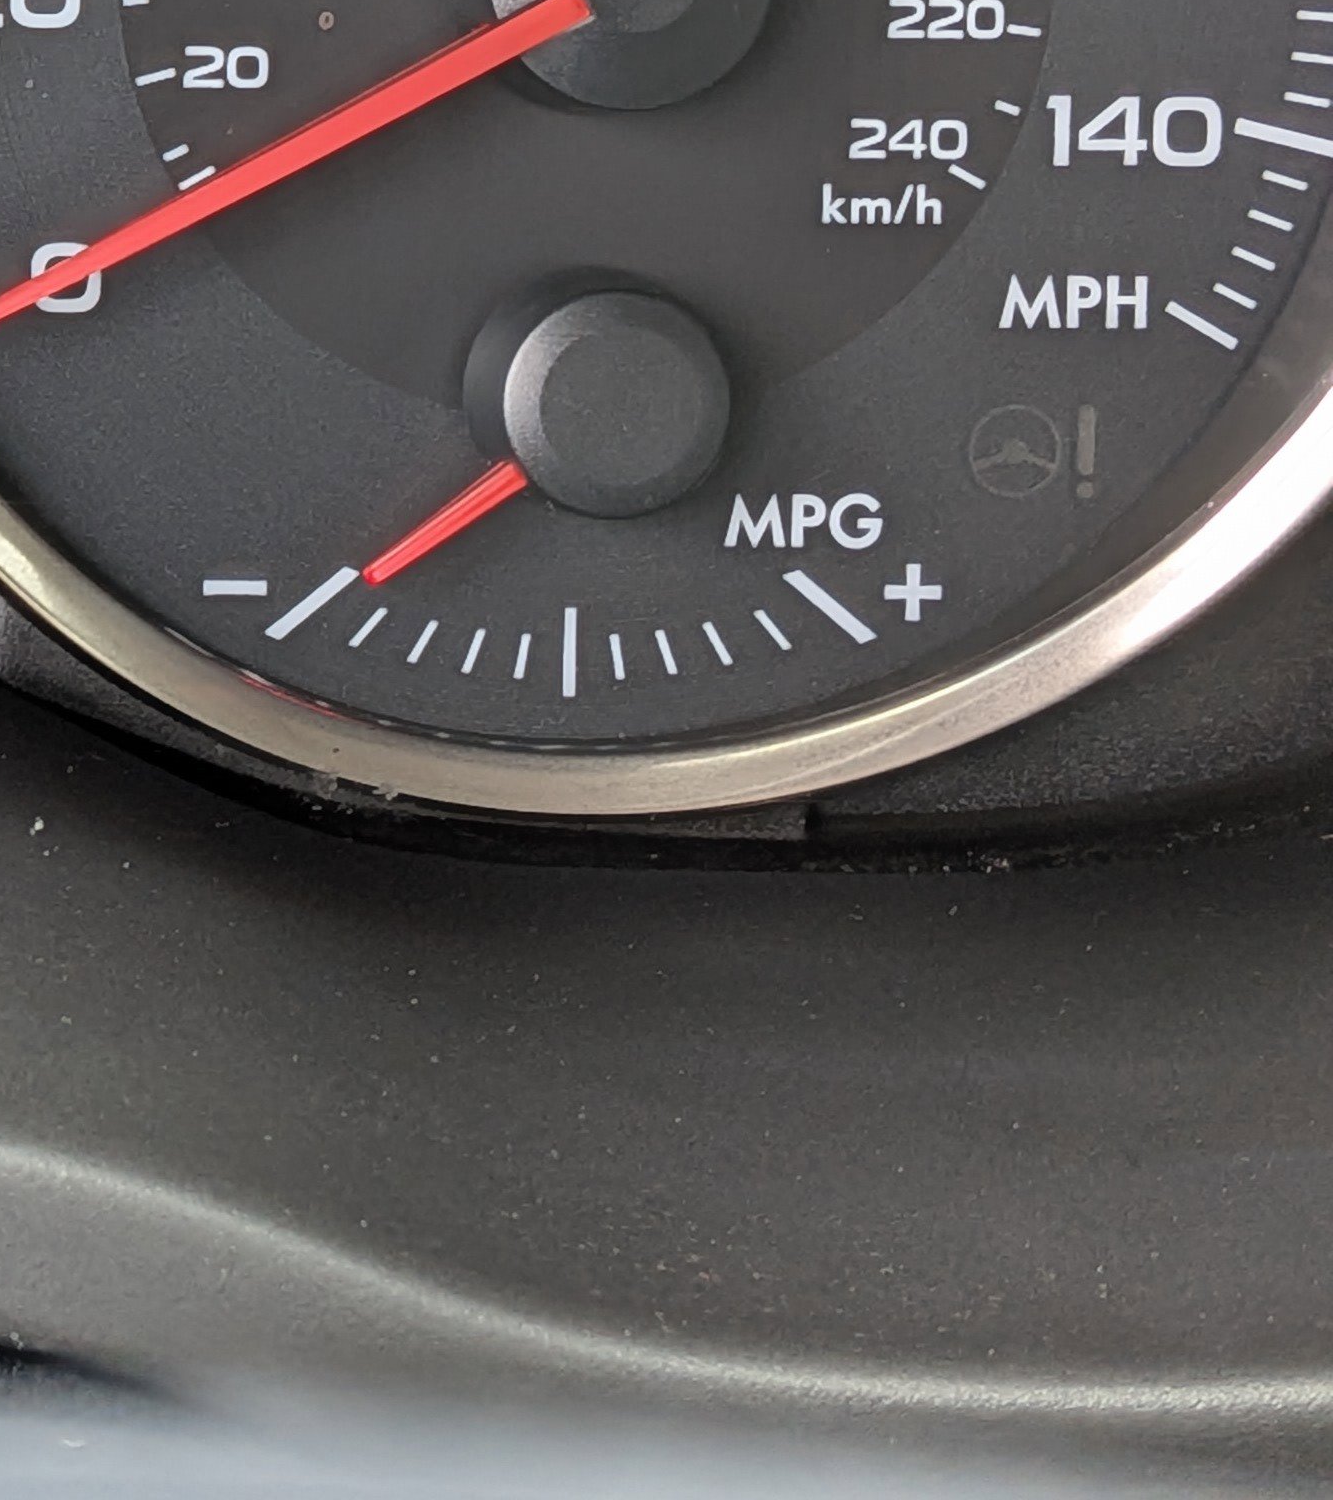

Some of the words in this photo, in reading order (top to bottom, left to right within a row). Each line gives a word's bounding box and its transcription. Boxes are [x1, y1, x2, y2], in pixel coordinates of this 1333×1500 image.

[183, 46, 268, 88] 20
[849, 119, 967, 159] 240
[1047, 95, 1222, 166] 140
[822, 184, 941, 224] km/h
[31, 242, 101, 312] 0
[999, 275, 1148, 328] MPH
[725, 493, 883, 549] MPG
